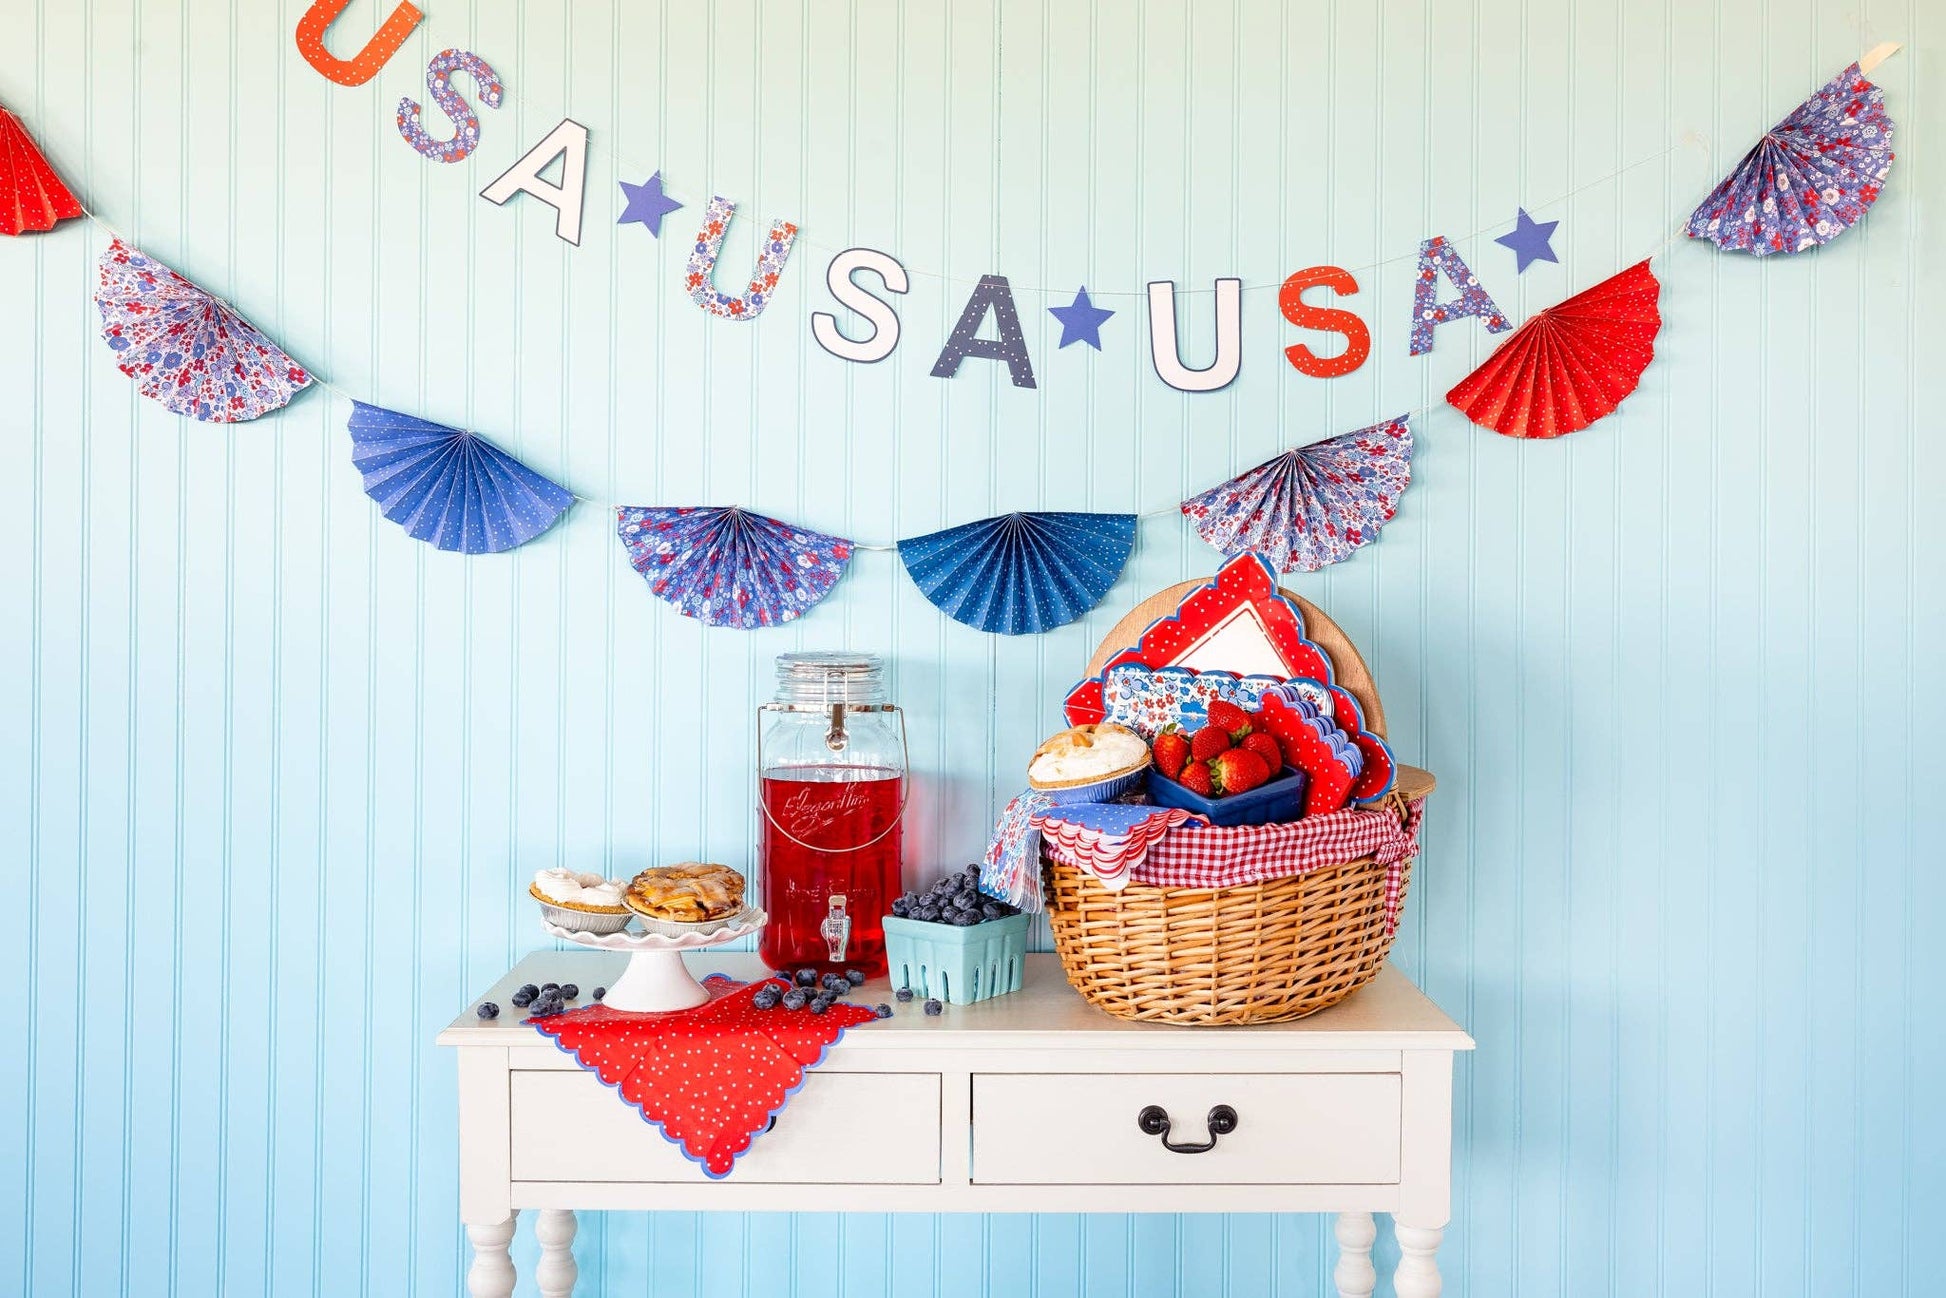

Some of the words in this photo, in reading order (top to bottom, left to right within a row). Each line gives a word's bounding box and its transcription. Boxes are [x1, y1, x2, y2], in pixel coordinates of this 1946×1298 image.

[295, 0, 590, 247] USA
[685, 195, 1037, 390] USA
[1147, 235, 1513, 394] USA
